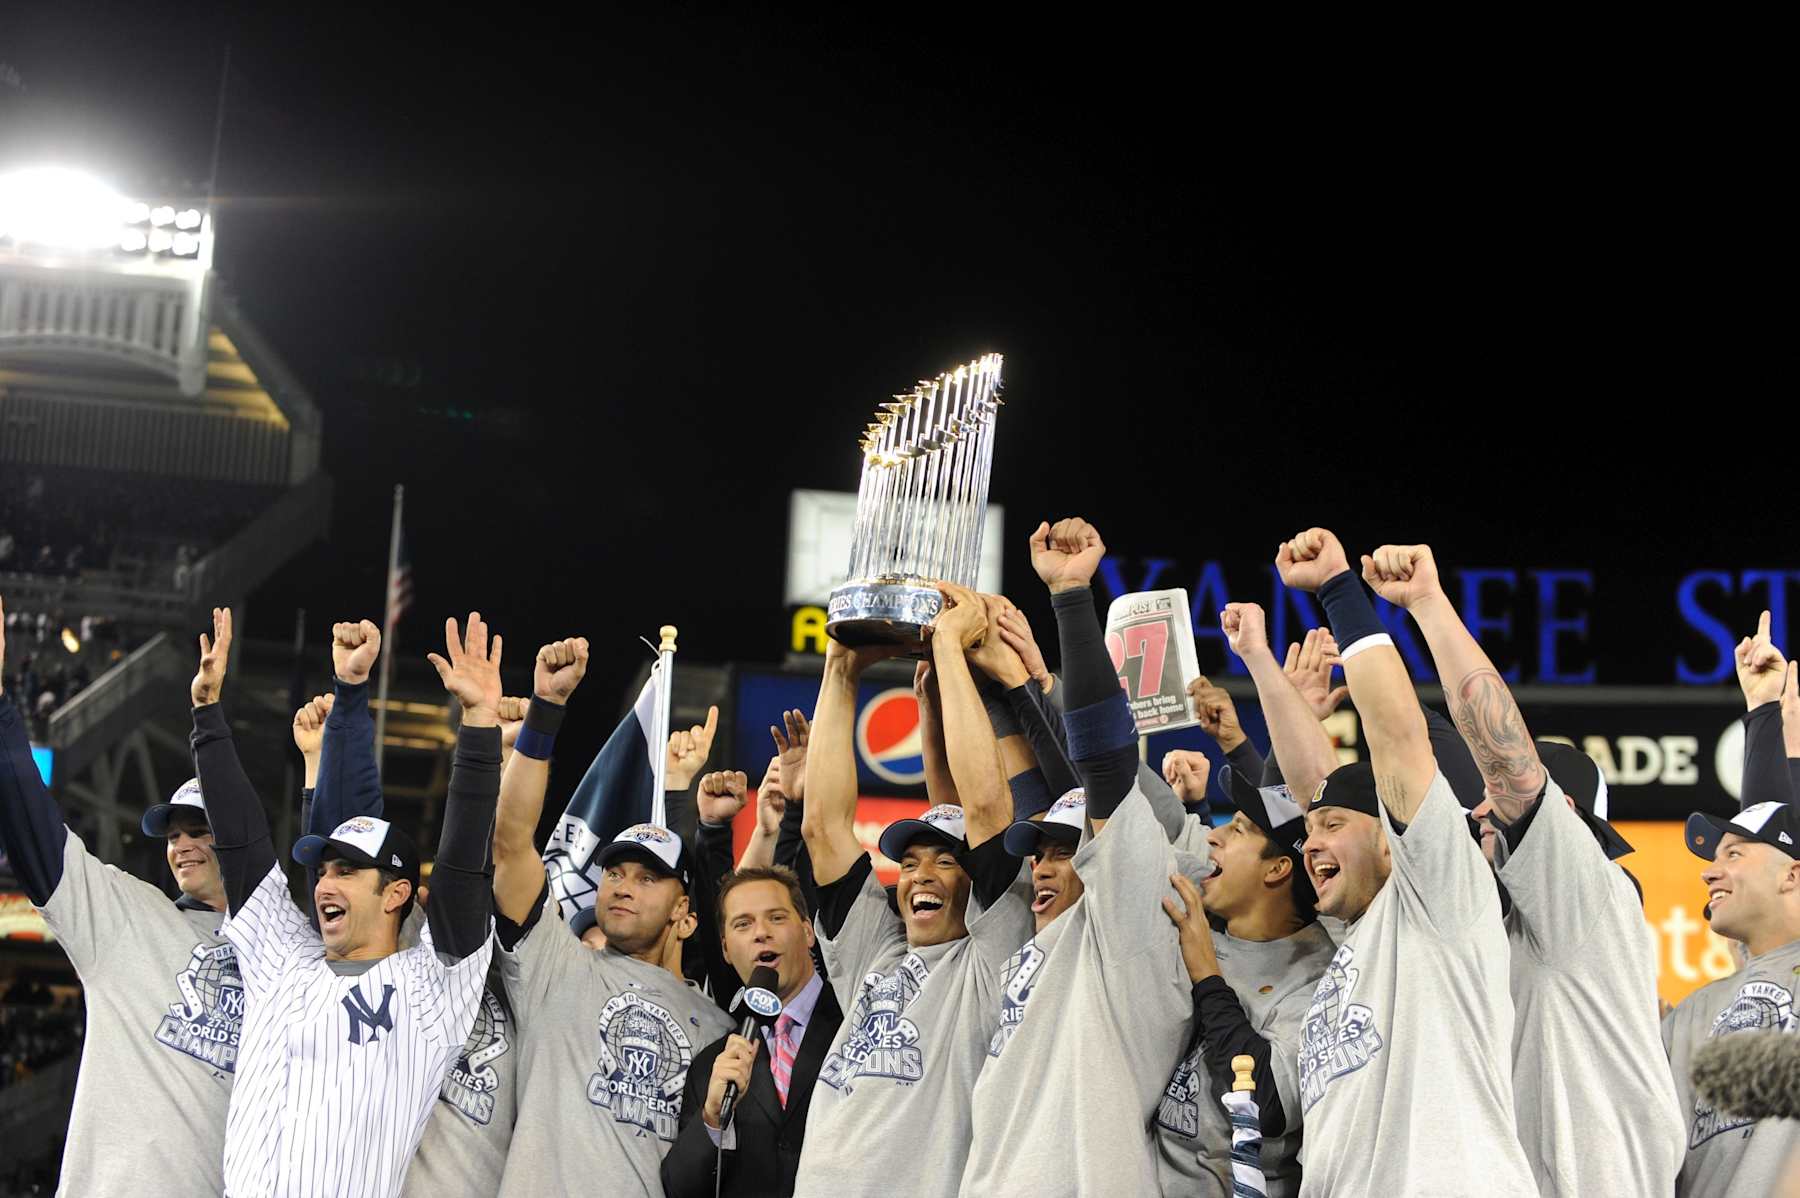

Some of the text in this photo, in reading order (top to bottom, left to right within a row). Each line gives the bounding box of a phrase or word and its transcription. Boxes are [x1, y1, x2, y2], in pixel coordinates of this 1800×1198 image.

[1097, 553, 1598, 685] ANEE
[1152, 695, 1177, 706] bring
[1159, 703, 1184, 715] home
[1537, 736, 1699, 786] ADE
[341, 984, 397, 1046] NY
[750, 990, 776, 1012] FOX
[648, 1004, 686, 1041] YANKEES
[627, 1050, 652, 1076] NY
